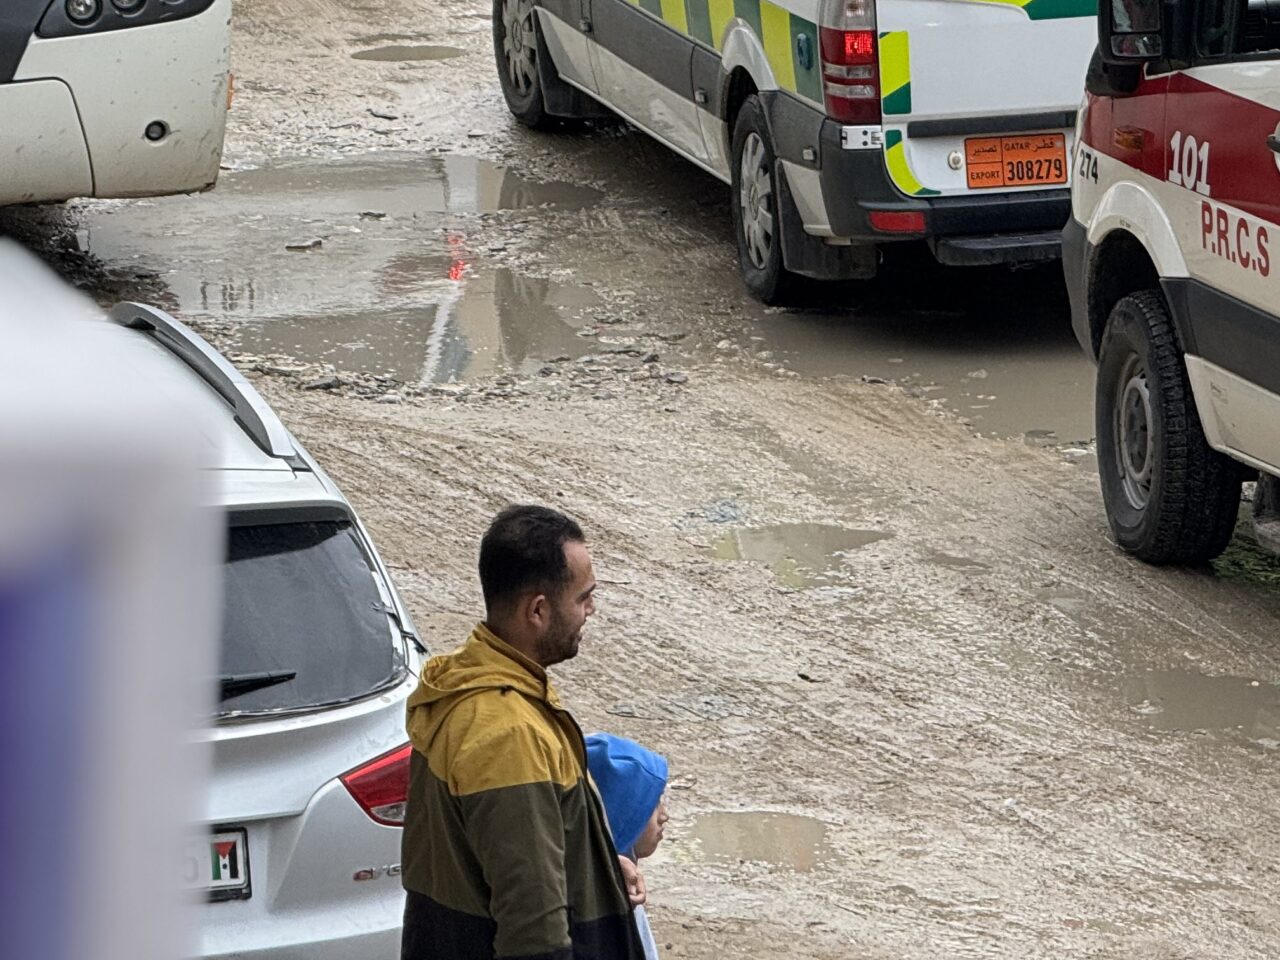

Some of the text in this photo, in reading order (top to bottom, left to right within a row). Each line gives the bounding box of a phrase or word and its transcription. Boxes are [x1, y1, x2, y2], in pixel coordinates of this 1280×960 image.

[1003, 142, 1031, 151] QATAR
[970, 170, 1001, 180] EXPORT
[1006, 158, 1063, 181] 308279
[1079, 148, 1099, 184] 274
[1168, 130, 1211, 197] 101
[1201, 200, 1270, 278] P.R.C.S
